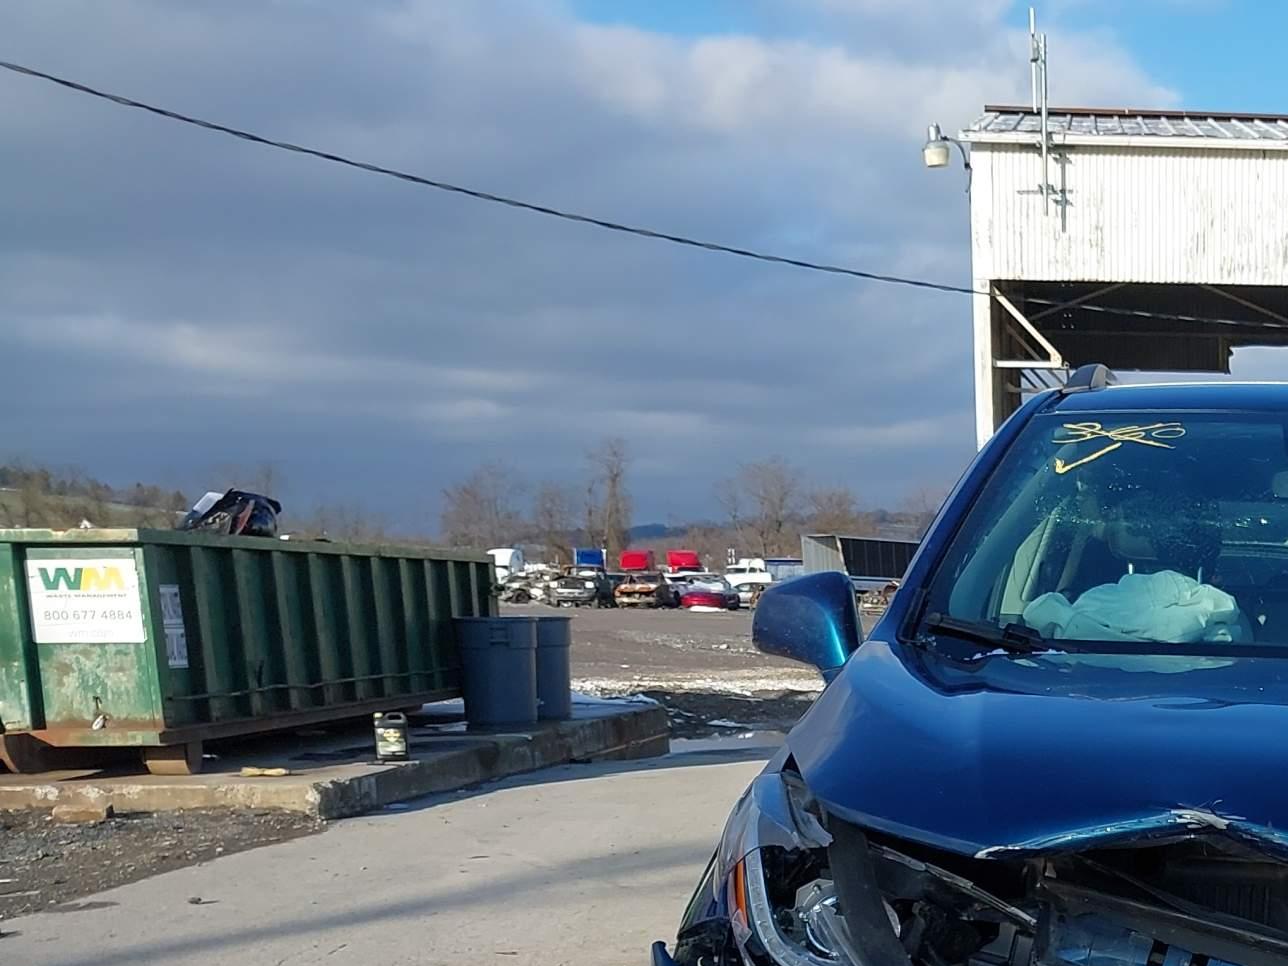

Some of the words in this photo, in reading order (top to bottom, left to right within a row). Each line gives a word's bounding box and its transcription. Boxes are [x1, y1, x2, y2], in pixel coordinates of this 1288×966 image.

[38, 567, 126, 592] WM
[43, 610, 69, 621] 800
[72, 610, 96, 621] 677
[100, 609, 133, 621] 4884
